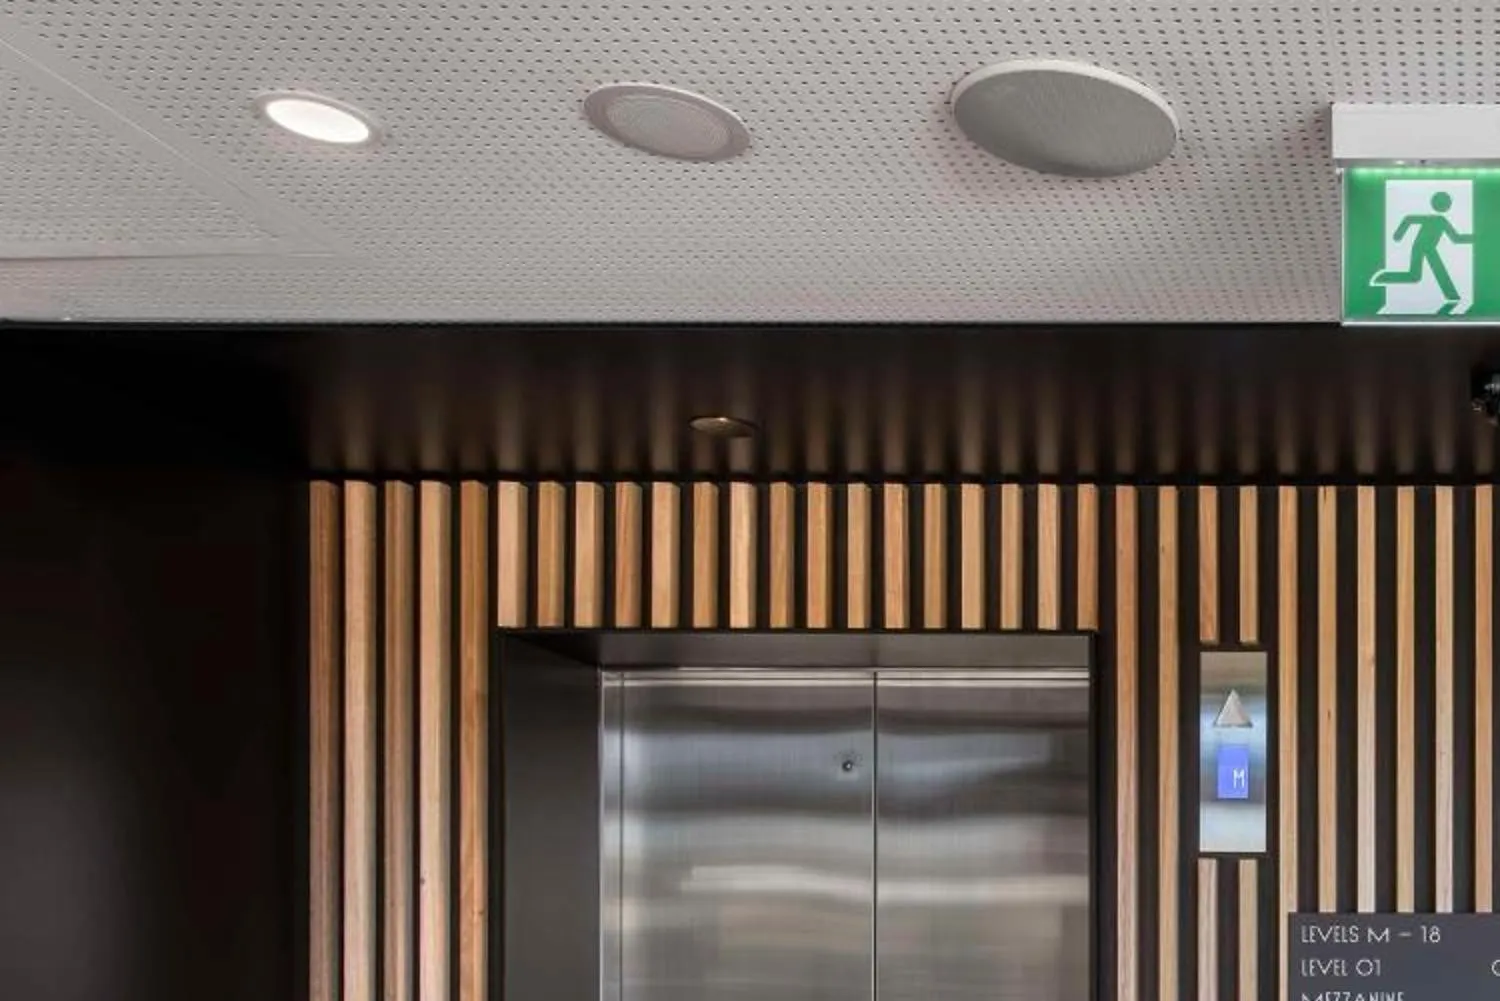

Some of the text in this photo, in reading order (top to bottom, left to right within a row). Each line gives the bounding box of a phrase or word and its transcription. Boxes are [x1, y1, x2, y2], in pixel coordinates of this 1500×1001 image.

[1232, 767, 1245, 789] M
[1302, 926, 1360, 943] LEVELS
[1367, 927, 1390, 943] M
[1420, 926, 1441, 943] 18
[1302, 959, 1347, 976] LEVEL
